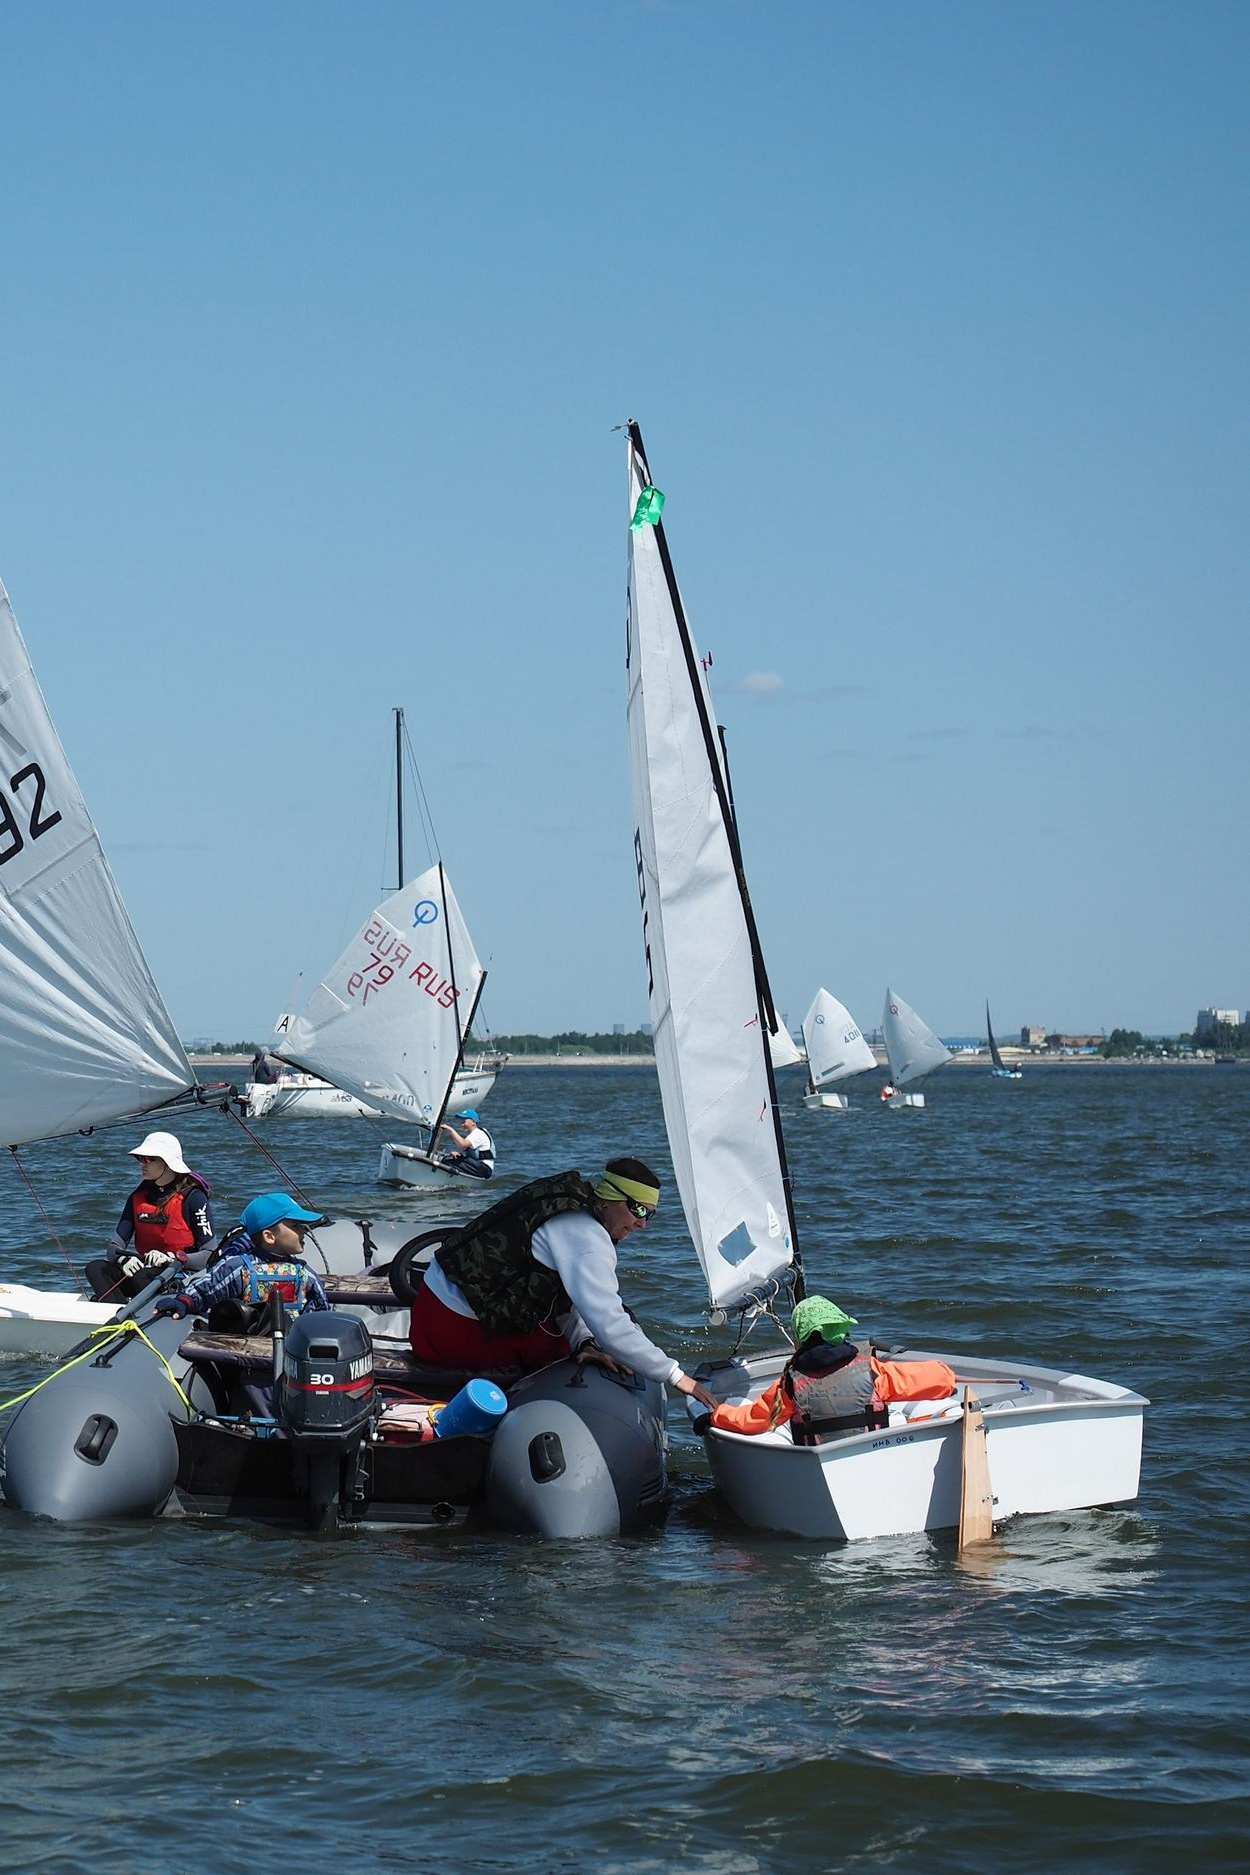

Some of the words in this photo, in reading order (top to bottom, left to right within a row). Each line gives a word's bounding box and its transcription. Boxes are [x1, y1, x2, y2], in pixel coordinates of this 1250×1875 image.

[361, 952, 395, 986] 79
[408, 961, 461, 1009] RUS
[194, 1202, 213, 1237] zhik
[310, 1373, 335, 1385] 30
